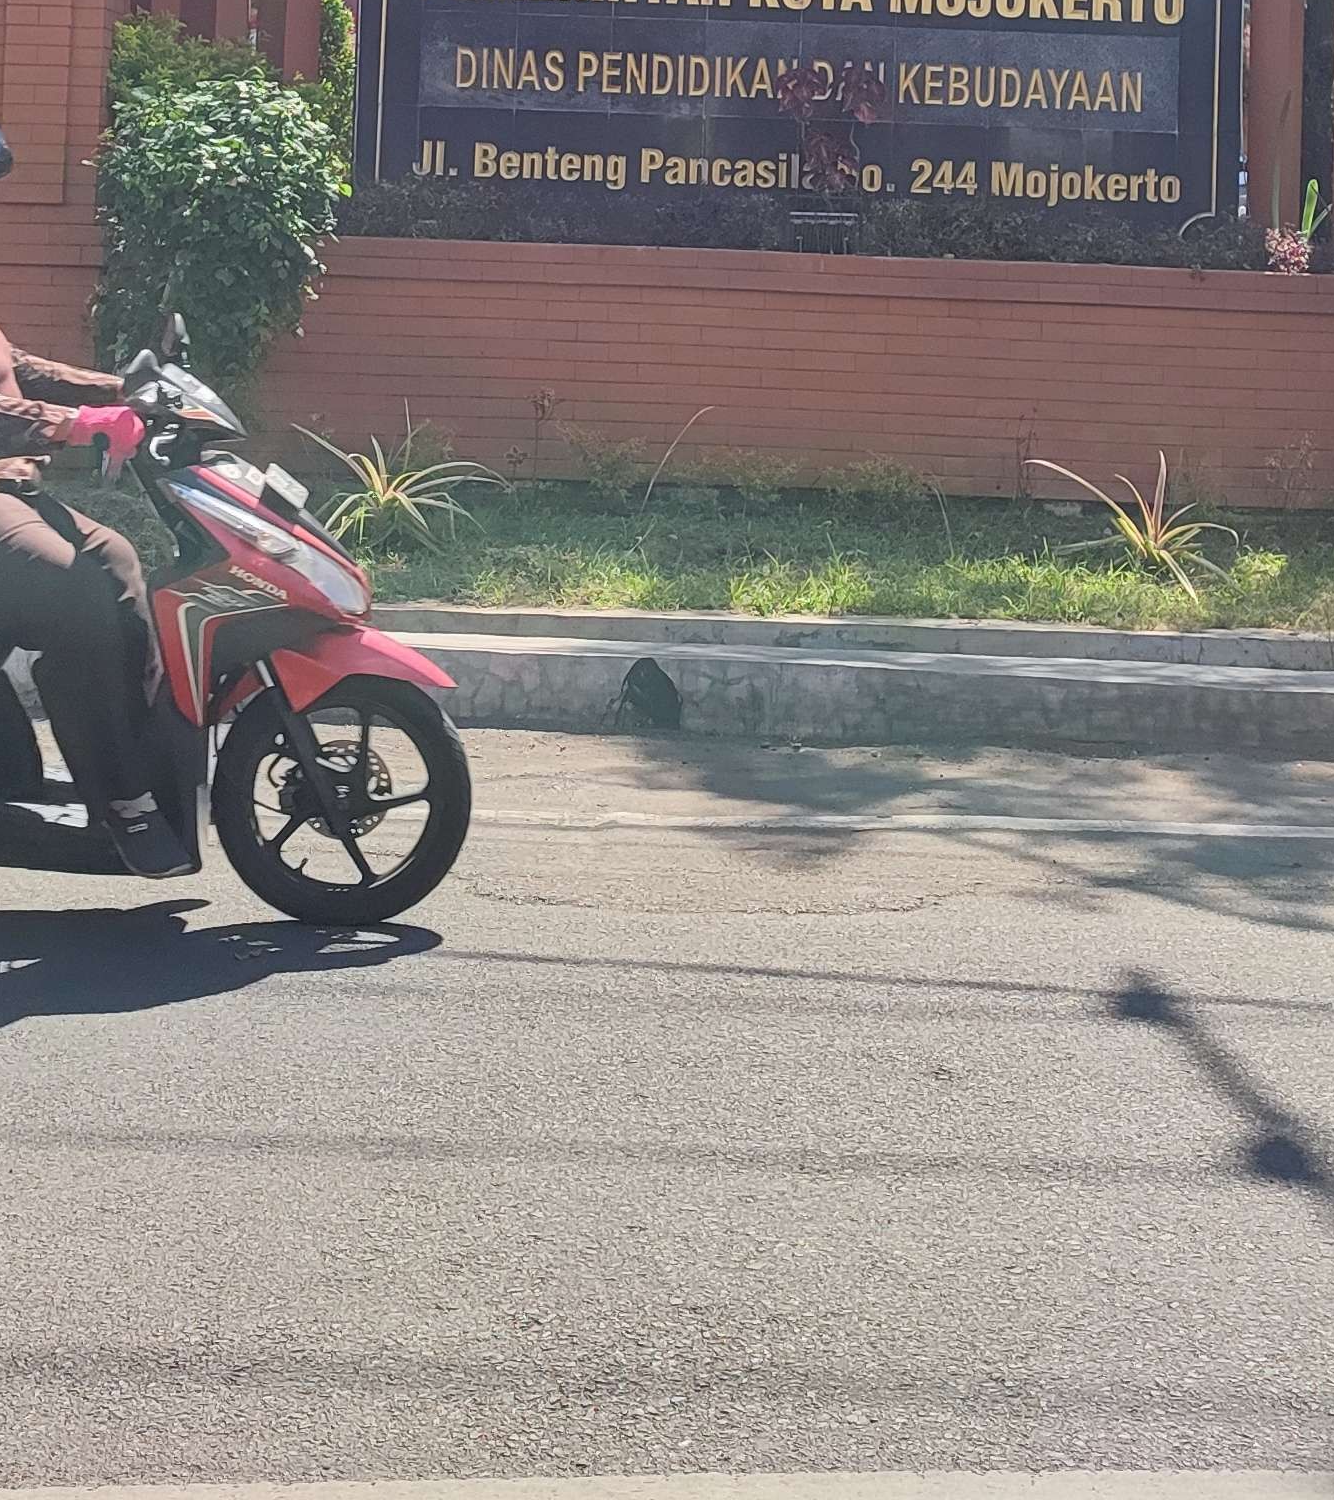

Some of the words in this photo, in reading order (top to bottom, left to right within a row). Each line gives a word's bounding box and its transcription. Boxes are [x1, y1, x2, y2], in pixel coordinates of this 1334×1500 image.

[456, 46, 564, 93] DINAS
[897, 62, 1143, 113] KEBUDAYAAN
[412, 139, 458, 177] Jl.
[473, 141, 627, 190] Benteng
[910, 158, 978, 195] 244
[991, 160, 1181, 207] Mojokerto
[229, 565, 288, 599] HONDA
